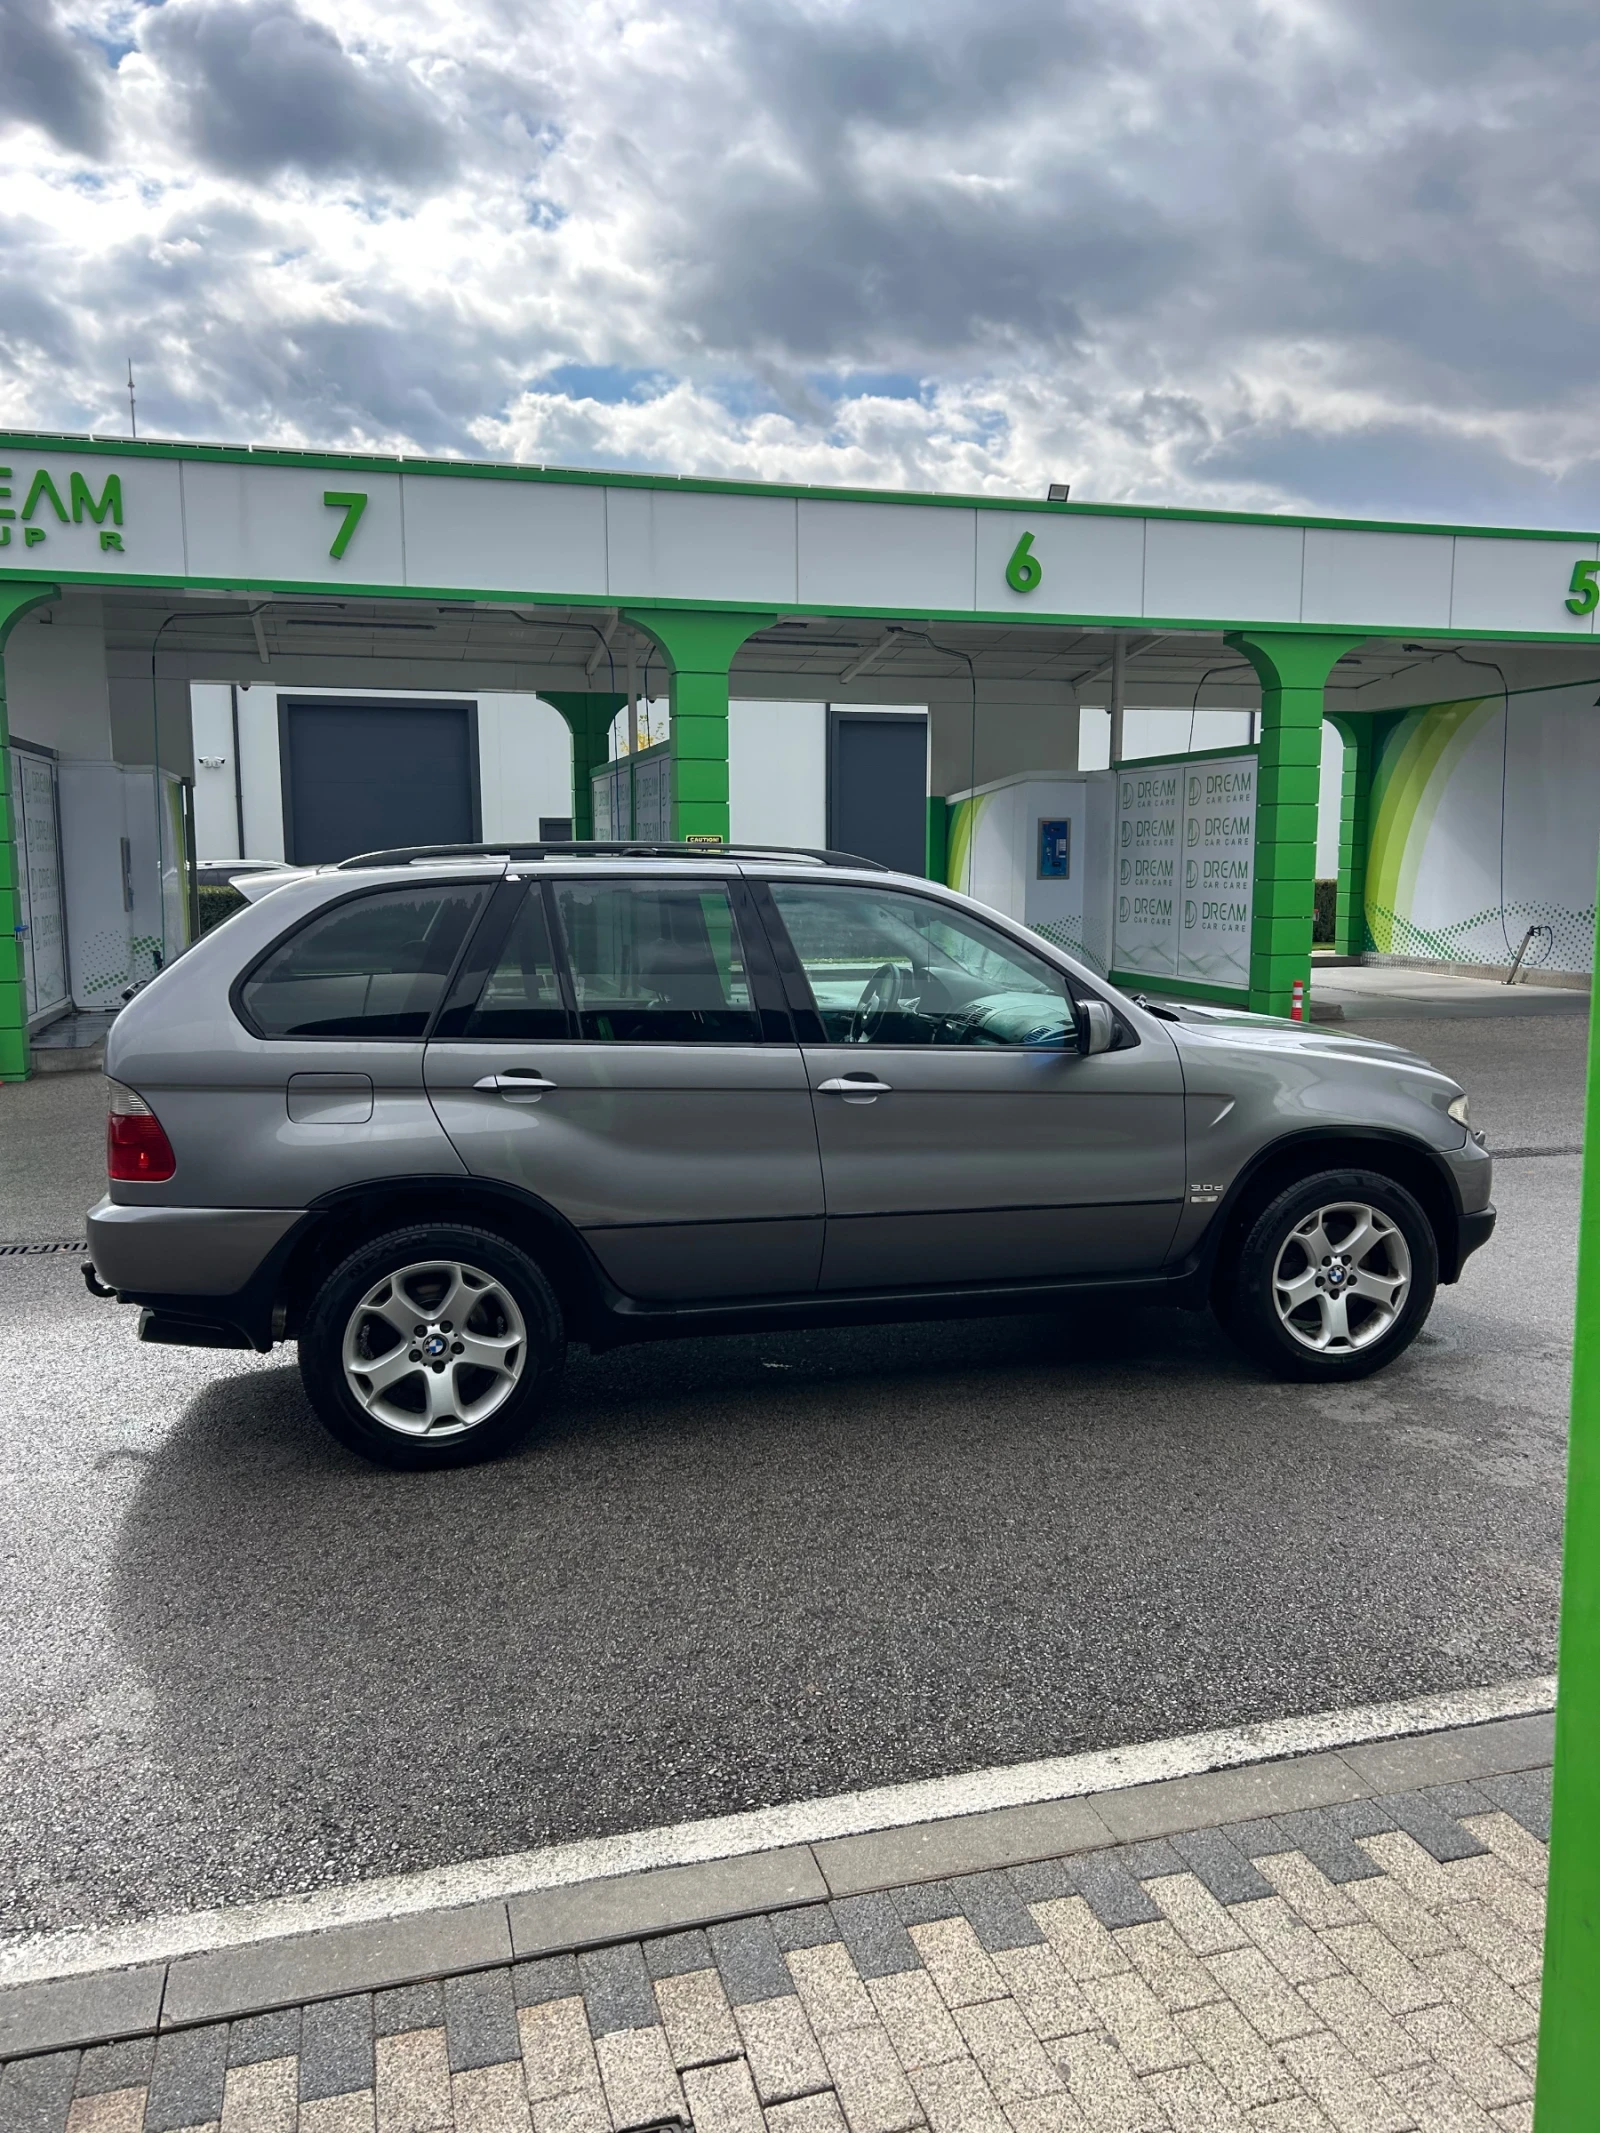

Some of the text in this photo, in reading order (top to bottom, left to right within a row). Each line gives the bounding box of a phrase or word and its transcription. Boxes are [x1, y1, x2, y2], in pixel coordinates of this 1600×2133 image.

[324, 491, 367, 560] 7
[1005, 531, 1042, 593] 6
[1565, 560, 1600, 615] 5
[1138, 779, 1176, 798] DREAM
[1206, 772, 1251, 794] DREAM
[1138, 798, 1175, 808] CAR CARE
[1206, 794, 1250, 804] CAR CARE
[1136, 819, 1175, 837] DREAM
[1205, 816, 1249, 836] DREAM
[1136, 838, 1174, 847] CAR CARE
[1205, 837, 1249, 846] CAR CARE
[1135, 859, 1174, 877] DREAM
[1203, 860, 1248, 879] DREAM
[1152, 879, 1173, 887] CARE
[1203, 881, 1248, 890] CAR CARE
[1134, 898, 1172, 916] DREAM
[1202, 902, 1247, 922] DREAM
[1134, 916, 1171, 926] CAR CARE
[1202, 922, 1246, 932] CAR CARE
